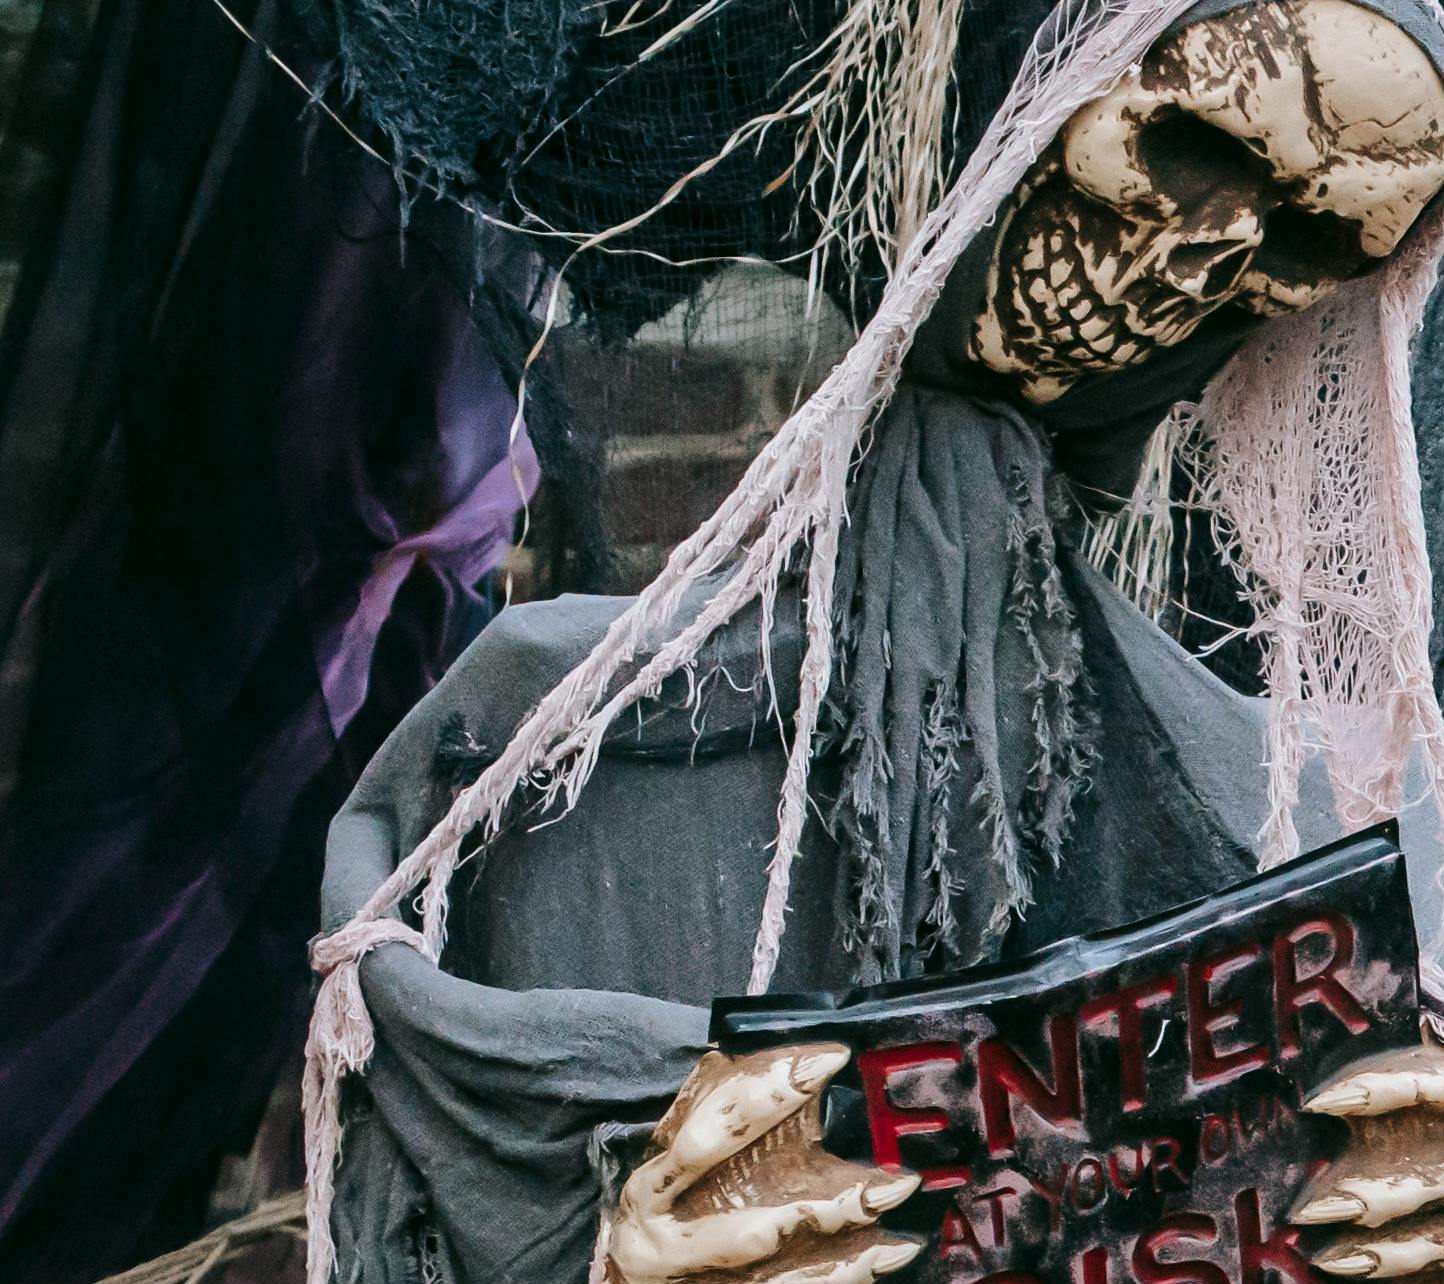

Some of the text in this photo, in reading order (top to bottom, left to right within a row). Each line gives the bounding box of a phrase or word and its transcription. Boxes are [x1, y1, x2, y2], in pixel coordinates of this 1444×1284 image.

[856, 912, 1370, 1191] ENTER
[937, 1188, 1009, 1263] AT
[1032, 1134, 1187, 1229] YOUR
